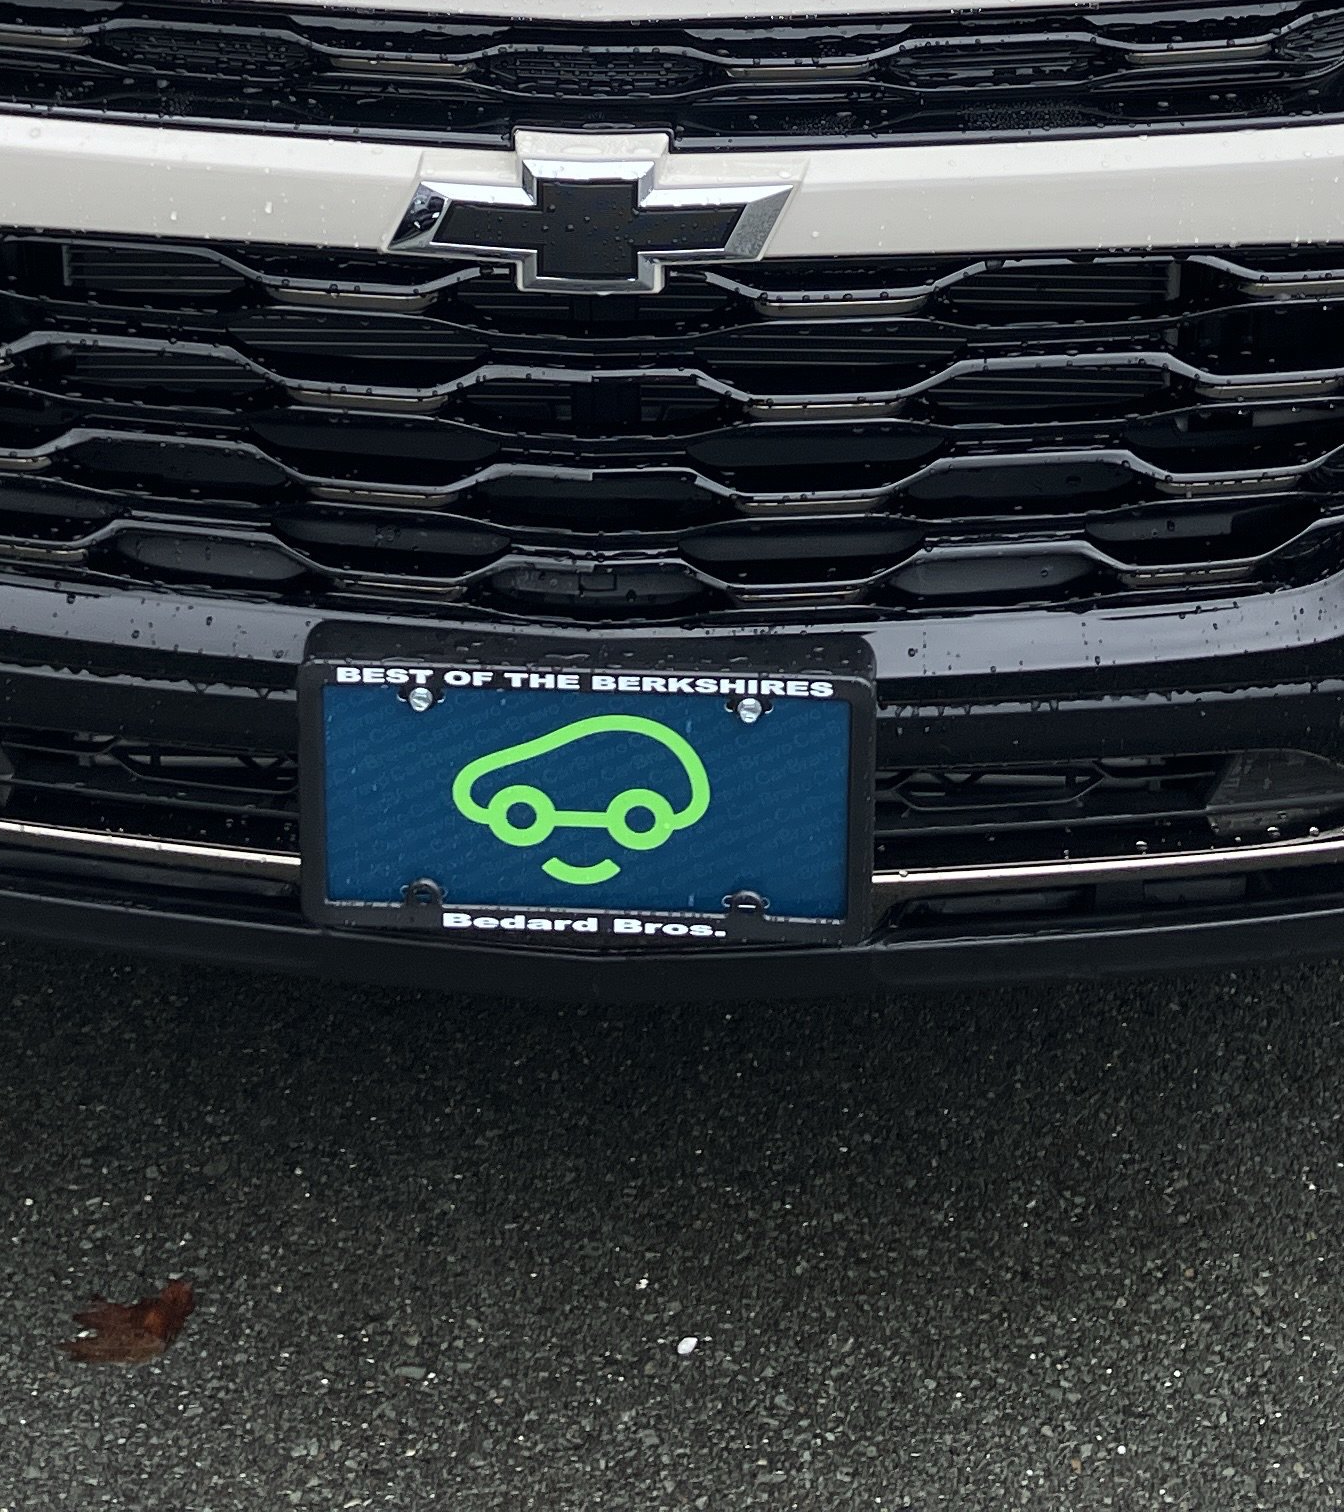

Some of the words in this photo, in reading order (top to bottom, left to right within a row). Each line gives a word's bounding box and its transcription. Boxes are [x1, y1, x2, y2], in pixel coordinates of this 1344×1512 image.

[336, 666, 434, 685] BEST
[444, 670, 494, 688] OF
[505, 672, 580, 692] THE
[592, 675, 833, 698] BERKSHIRES
[442, 912, 599, 934] Bedard
[613, 918, 727, 938] Bros.
